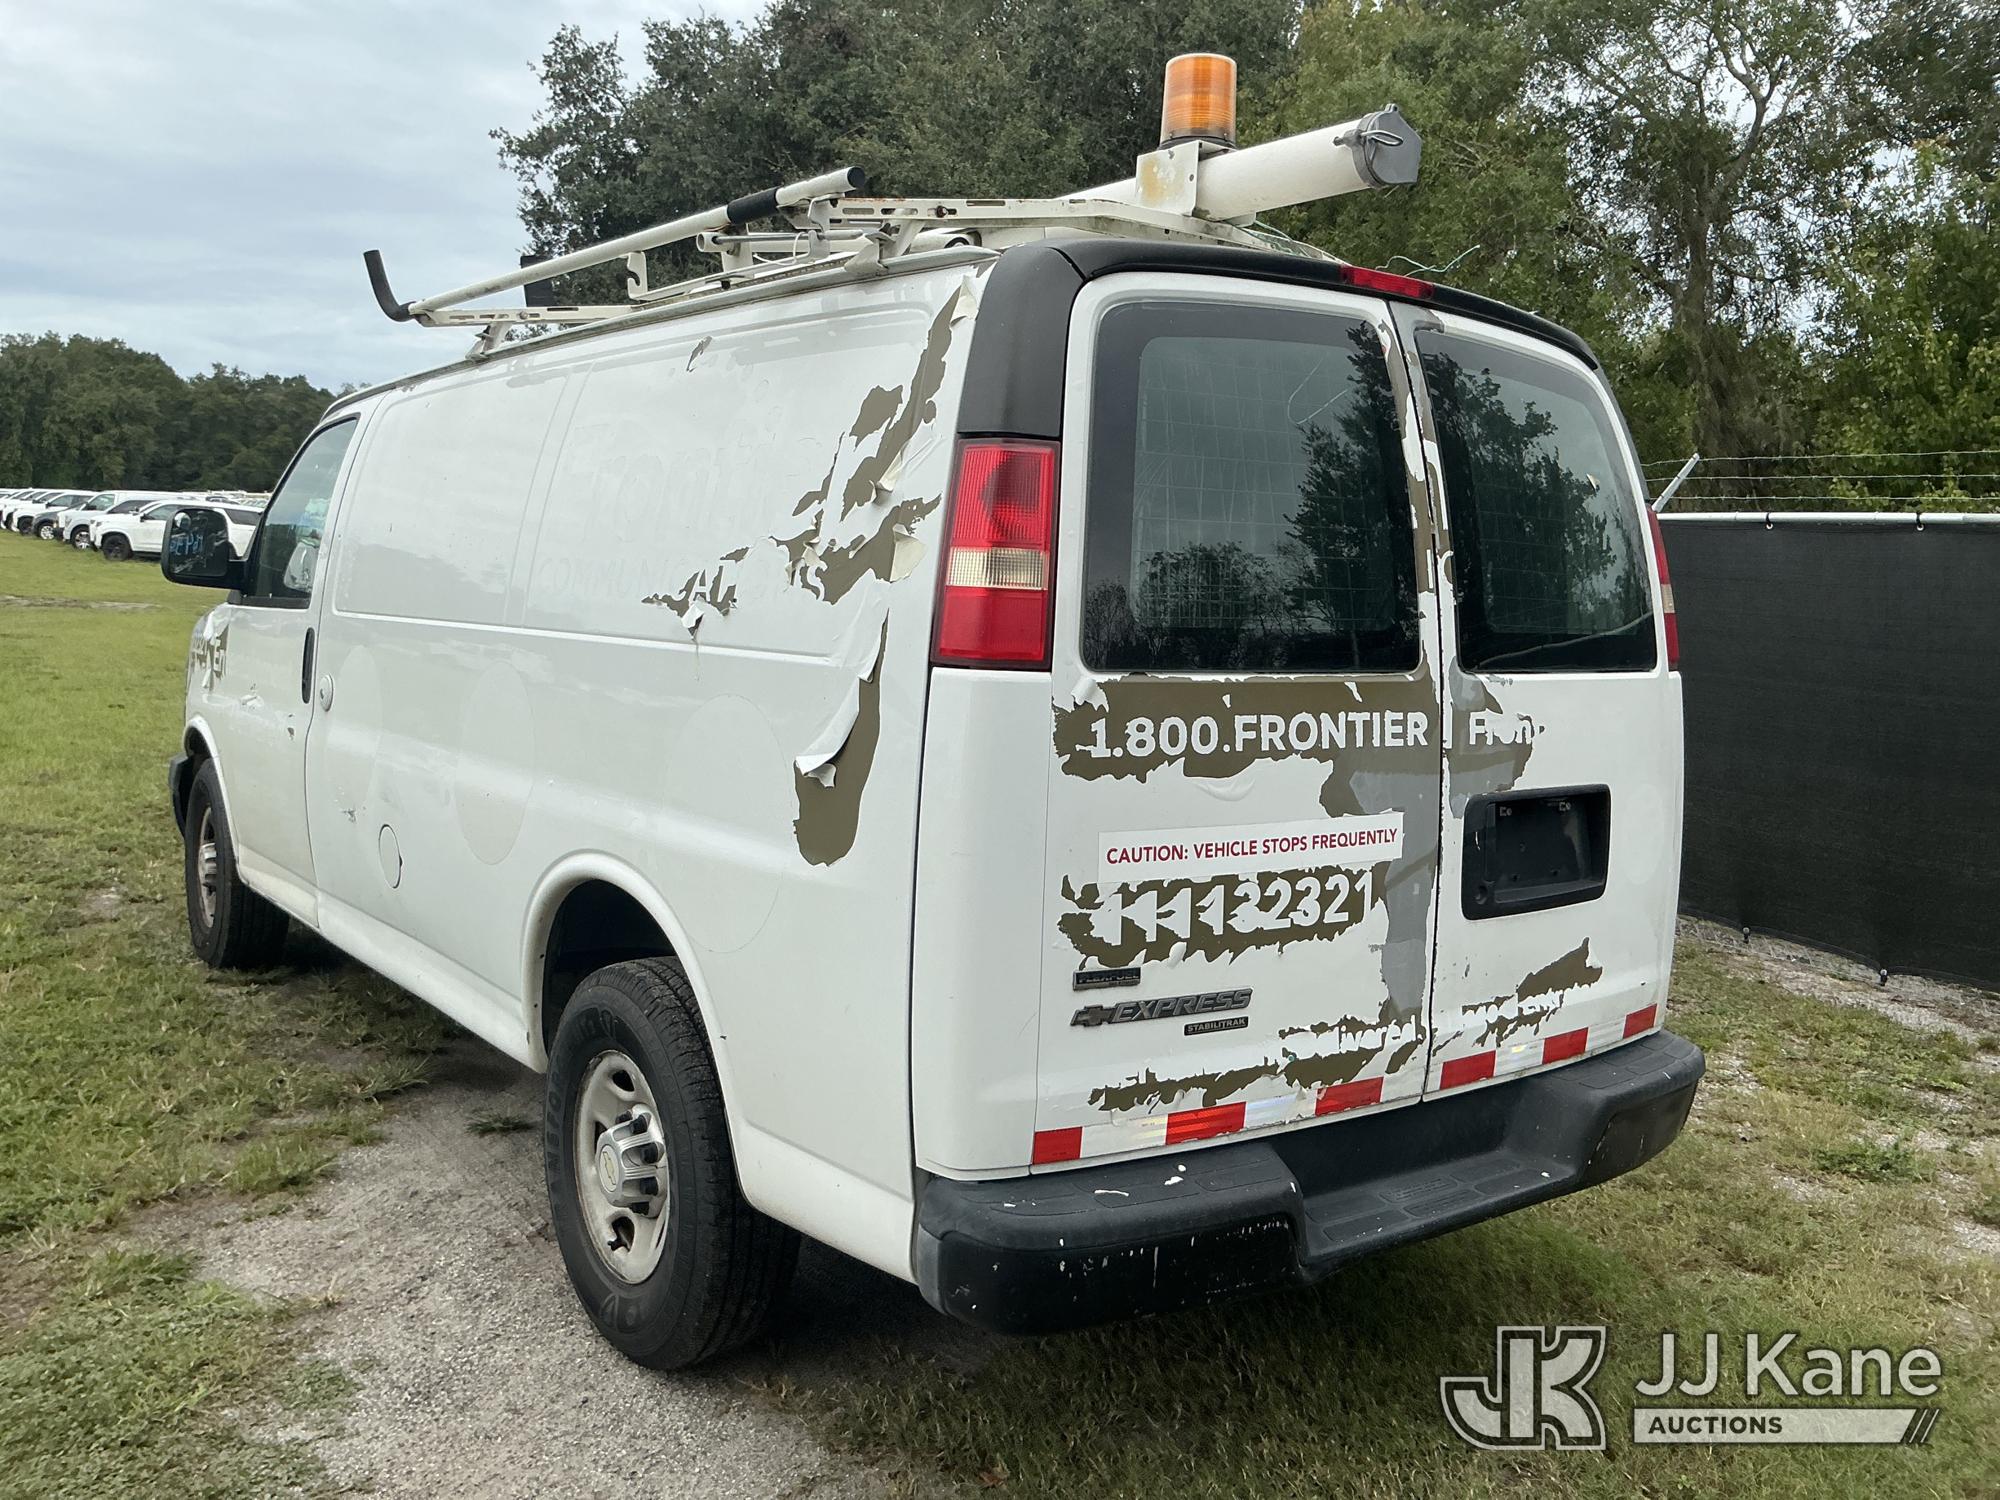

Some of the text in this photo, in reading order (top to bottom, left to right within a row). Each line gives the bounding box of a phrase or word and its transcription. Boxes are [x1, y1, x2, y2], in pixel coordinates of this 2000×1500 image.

[1089, 708, 1429, 758] 1.800.FRONTIER
[1106, 828, 1398, 864] CAUTION: VEHICLE STOPS FREQUENTLY
[1110, 988, 1252, 1024] EXPRESS
[1187, 1018, 1246, 1034] STABILITRAK
